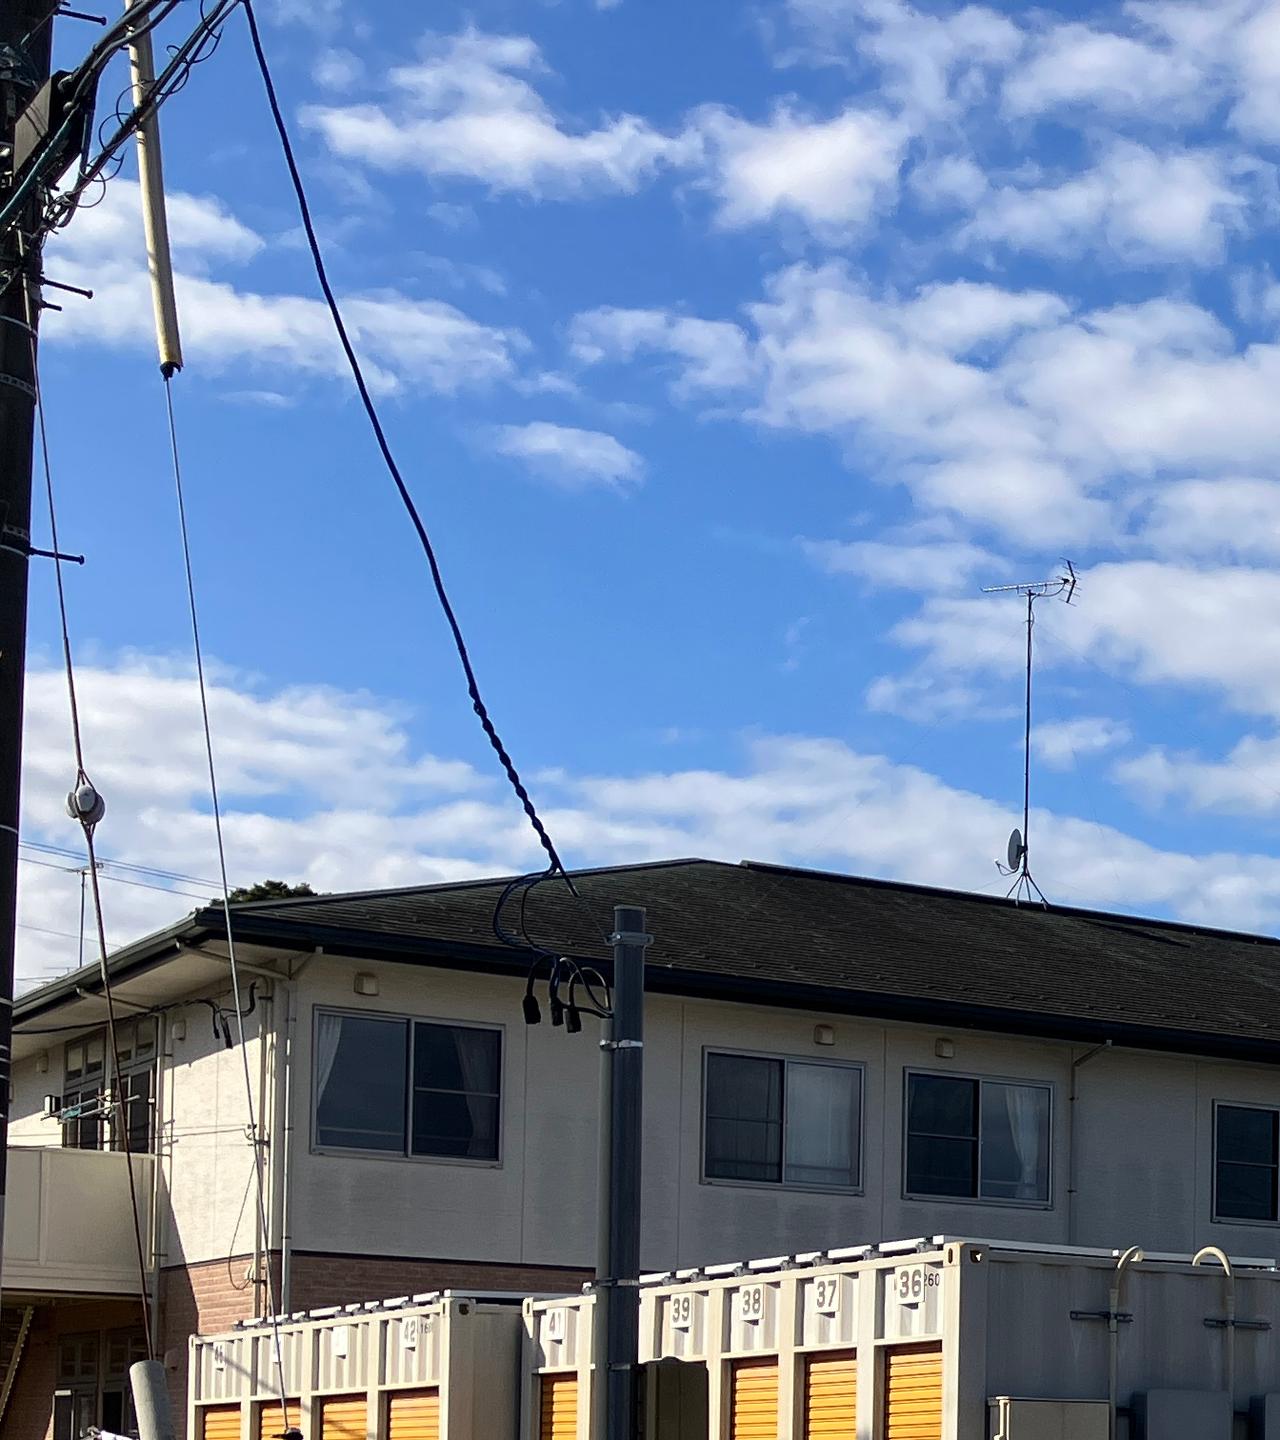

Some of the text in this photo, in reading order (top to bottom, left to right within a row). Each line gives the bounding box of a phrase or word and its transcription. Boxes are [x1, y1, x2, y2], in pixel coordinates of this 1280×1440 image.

[816, 1279, 838, 1309] 37
[899, 1269, 922, 1299] 36
[672, 1296, 691, 1324] 39
[742, 1286, 761, 1316] 38
